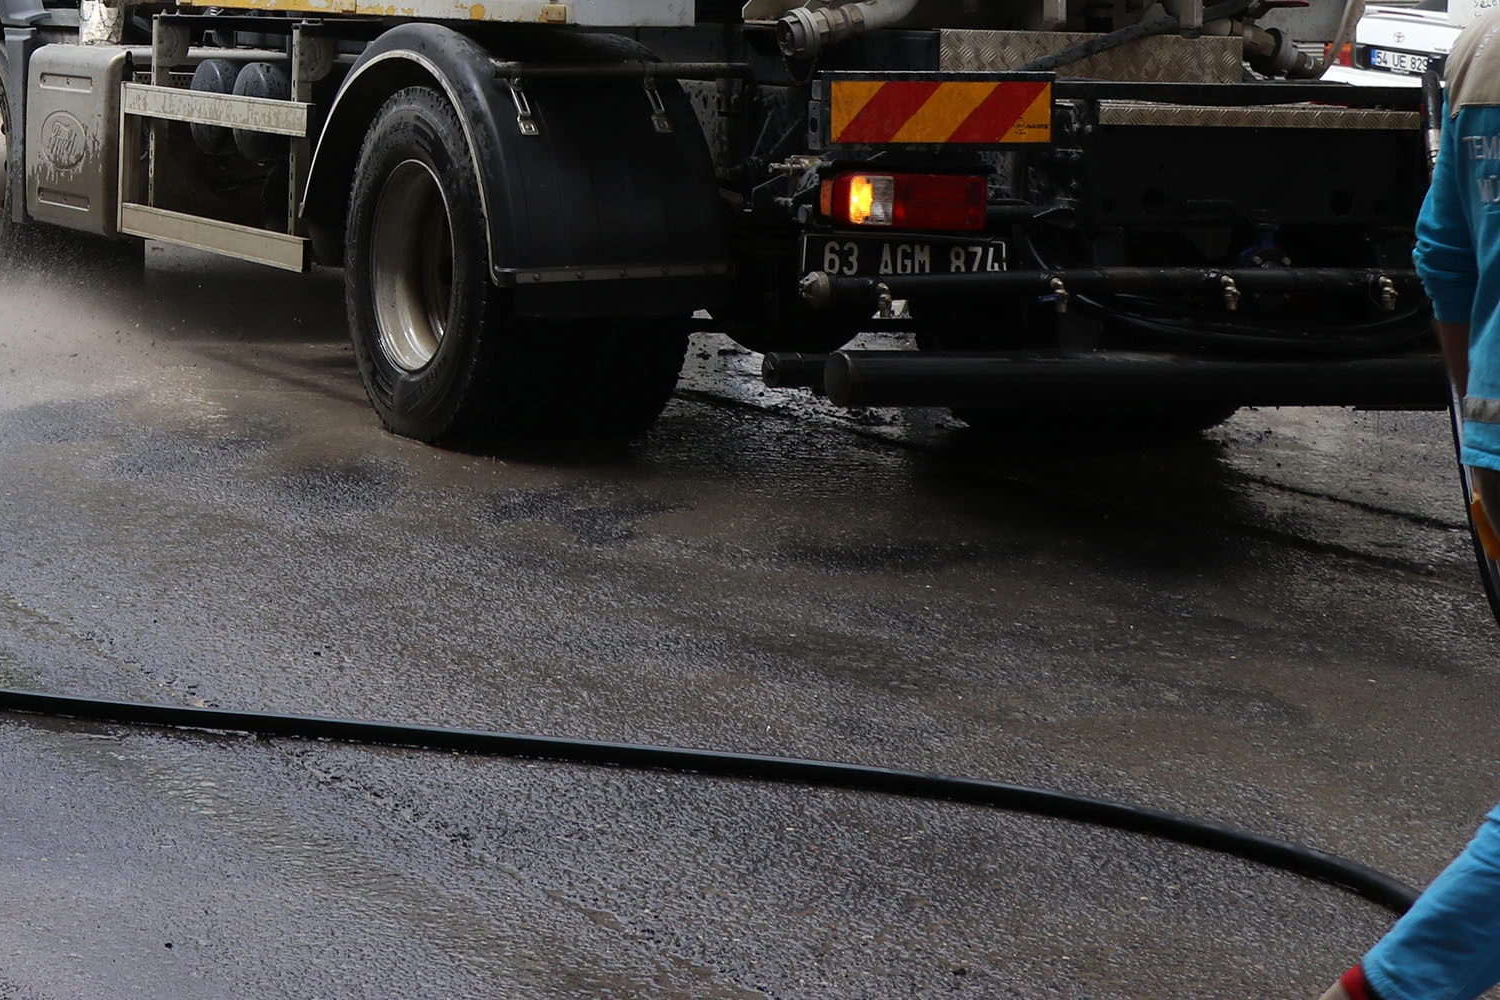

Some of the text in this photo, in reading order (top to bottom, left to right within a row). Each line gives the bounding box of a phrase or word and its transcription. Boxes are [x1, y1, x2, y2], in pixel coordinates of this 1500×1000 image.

[1376, 51, 1389, 66] 54
[1392, 53, 1407, 68] UE
[1410, 56, 1429, 72] 829
[823, 241, 858, 276] 63
[879, 243, 931, 275] AGM
